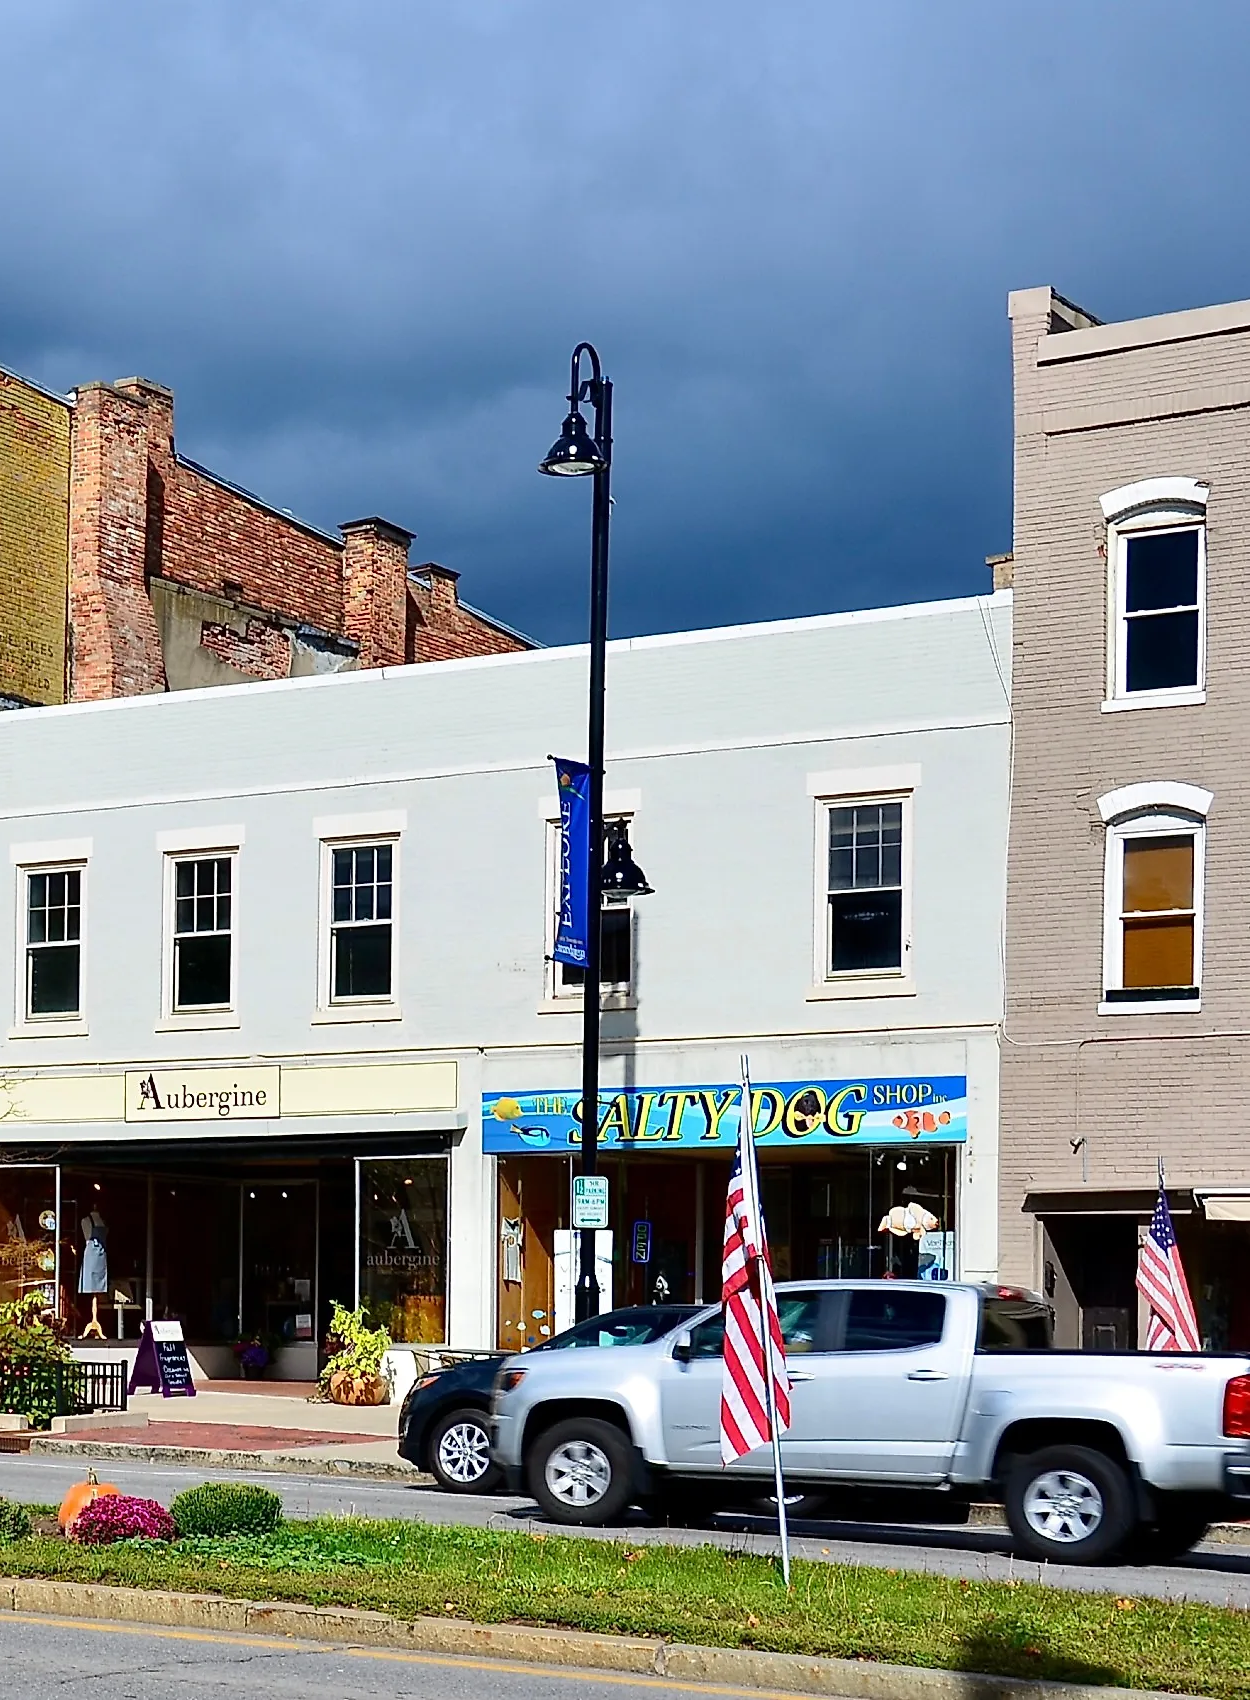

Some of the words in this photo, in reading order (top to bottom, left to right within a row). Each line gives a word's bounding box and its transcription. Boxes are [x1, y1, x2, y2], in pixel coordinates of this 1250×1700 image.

[136, 1072, 267, 1116] Aubergine
[534, 1096, 566, 1115] THE
[750, 1084, 867, 1138] DOG
[872, 1083, 933, 1105] SHOP
[366, 1249, 440, 1271] aubergine
[635, 1224, 647, 1260] OPEN
